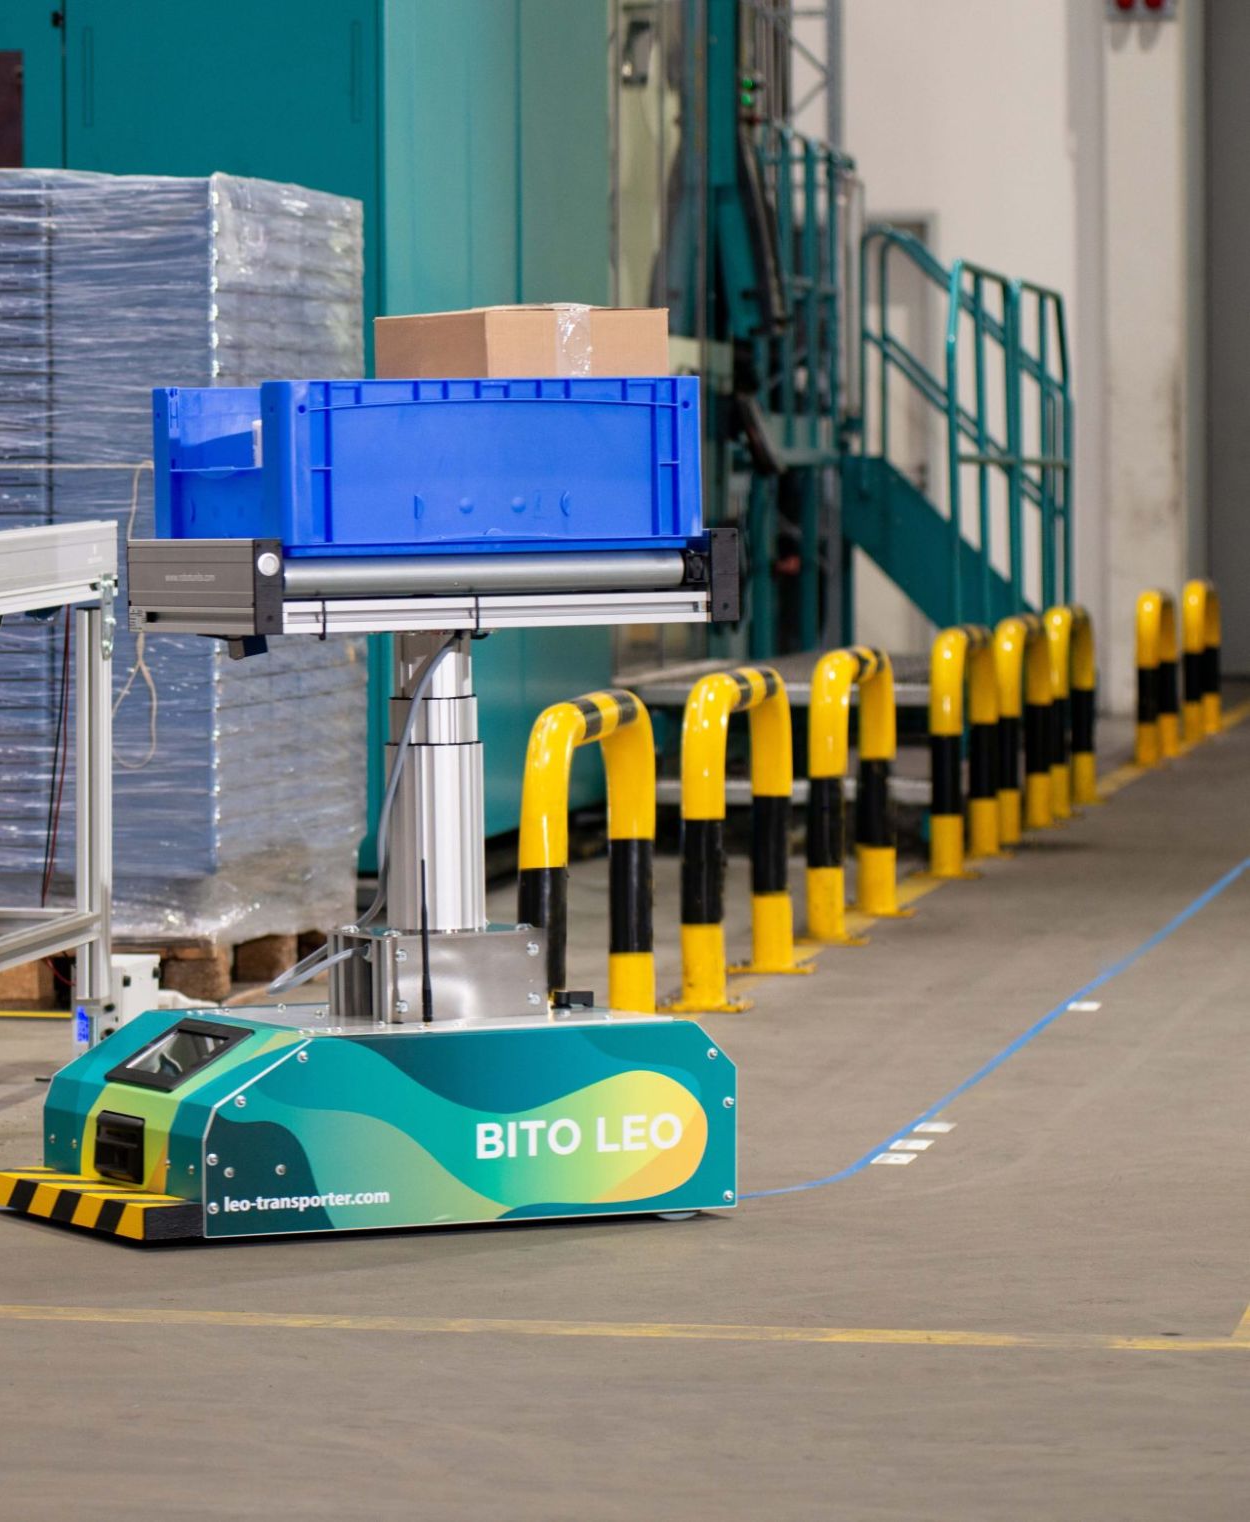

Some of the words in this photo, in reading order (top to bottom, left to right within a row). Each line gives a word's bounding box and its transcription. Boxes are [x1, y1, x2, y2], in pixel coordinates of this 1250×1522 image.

[476, 1118, 582, 1160] BITO
[596, 1112, 683, 1153] LEO
[223, 1191, 391, 1212] leo-transporter.com
